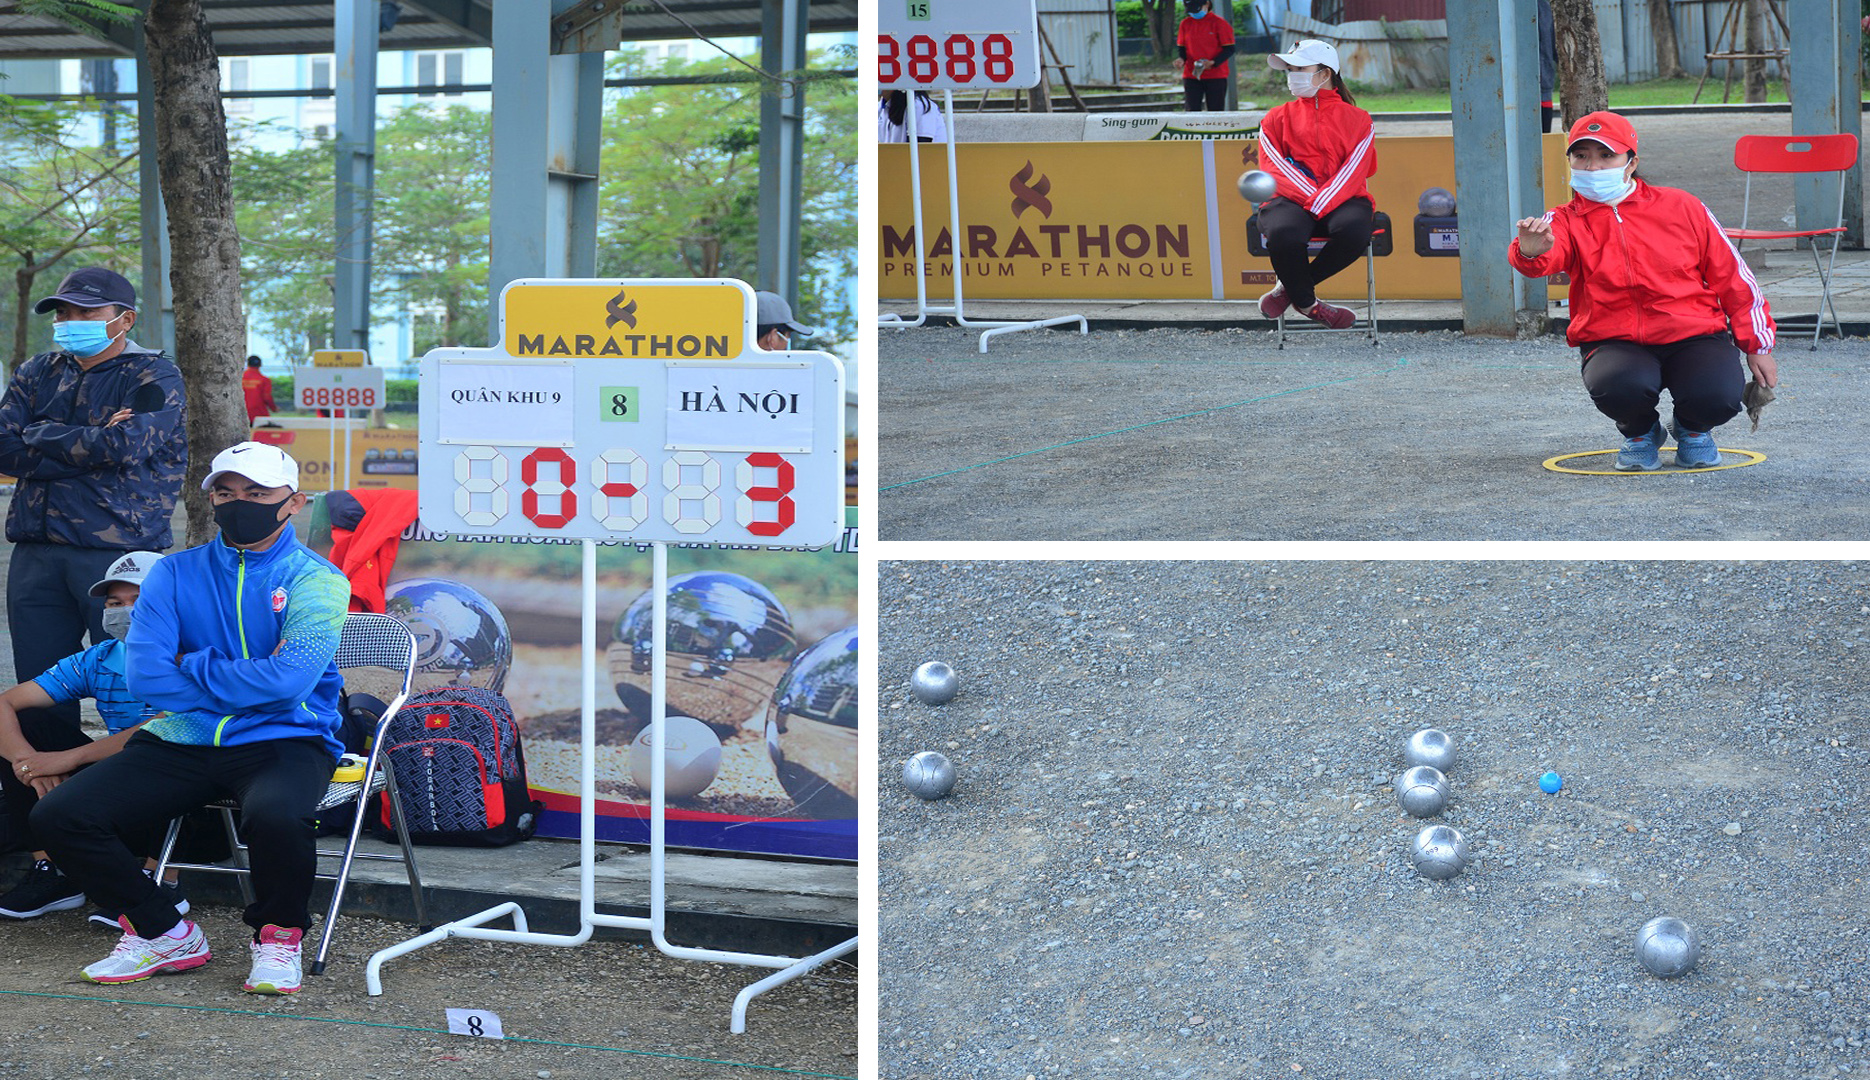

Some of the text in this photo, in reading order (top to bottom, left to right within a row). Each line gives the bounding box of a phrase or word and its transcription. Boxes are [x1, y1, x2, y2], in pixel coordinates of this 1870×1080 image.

[910, 4, 928, 17] 15
[1101, 118, 1158, 129] Sing-gum
[881, 224, 1190, 259] MARATHON
[885, 262, 1194, 278] PREMIUM PETANQUE
[518, 333, 729, 357] MARATHON
[451, 387, 562, 404] QUÂN KHU 9
[611, 393, 628, 416] 8
[679, 384, 800, 420] HÀ NỘI
[745, 452, 796, 537] 3
[467, 1015, 485, 1037] 8
